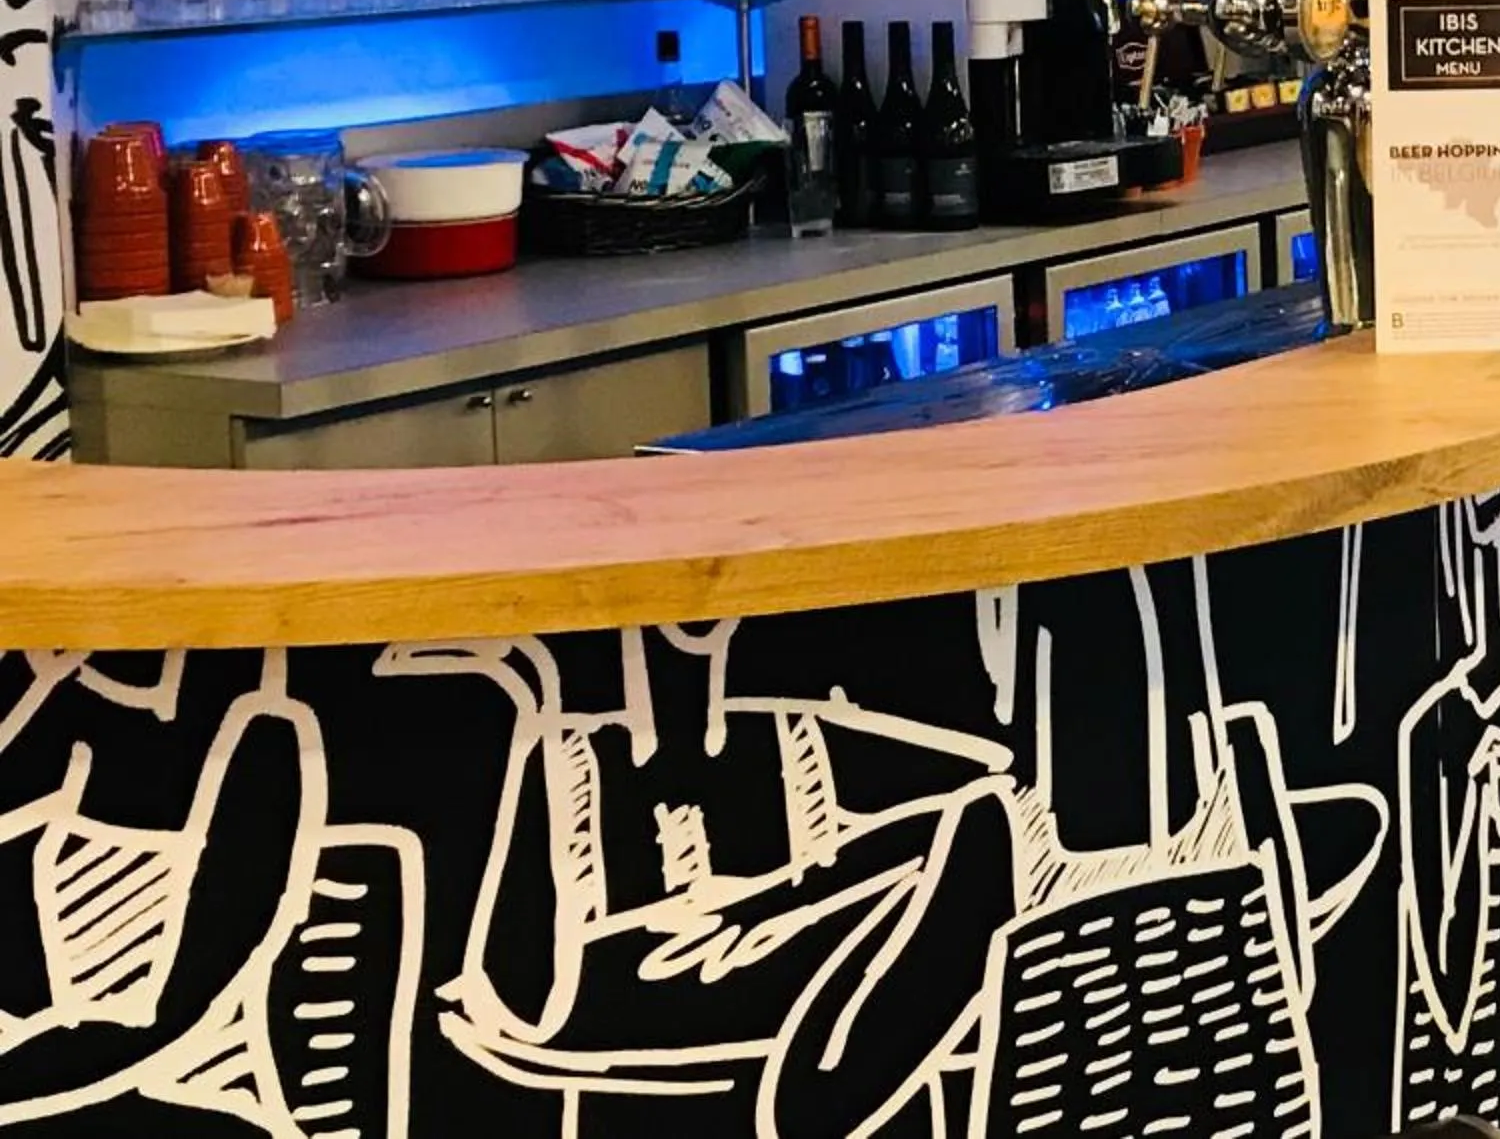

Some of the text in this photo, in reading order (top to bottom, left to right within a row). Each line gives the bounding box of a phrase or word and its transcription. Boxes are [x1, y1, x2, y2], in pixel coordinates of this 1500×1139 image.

[1439, 12, 1479, 32] IBIS
[1435, 61, 1481, 76] MENU
[1389, 145, 1433, 159] BEER
